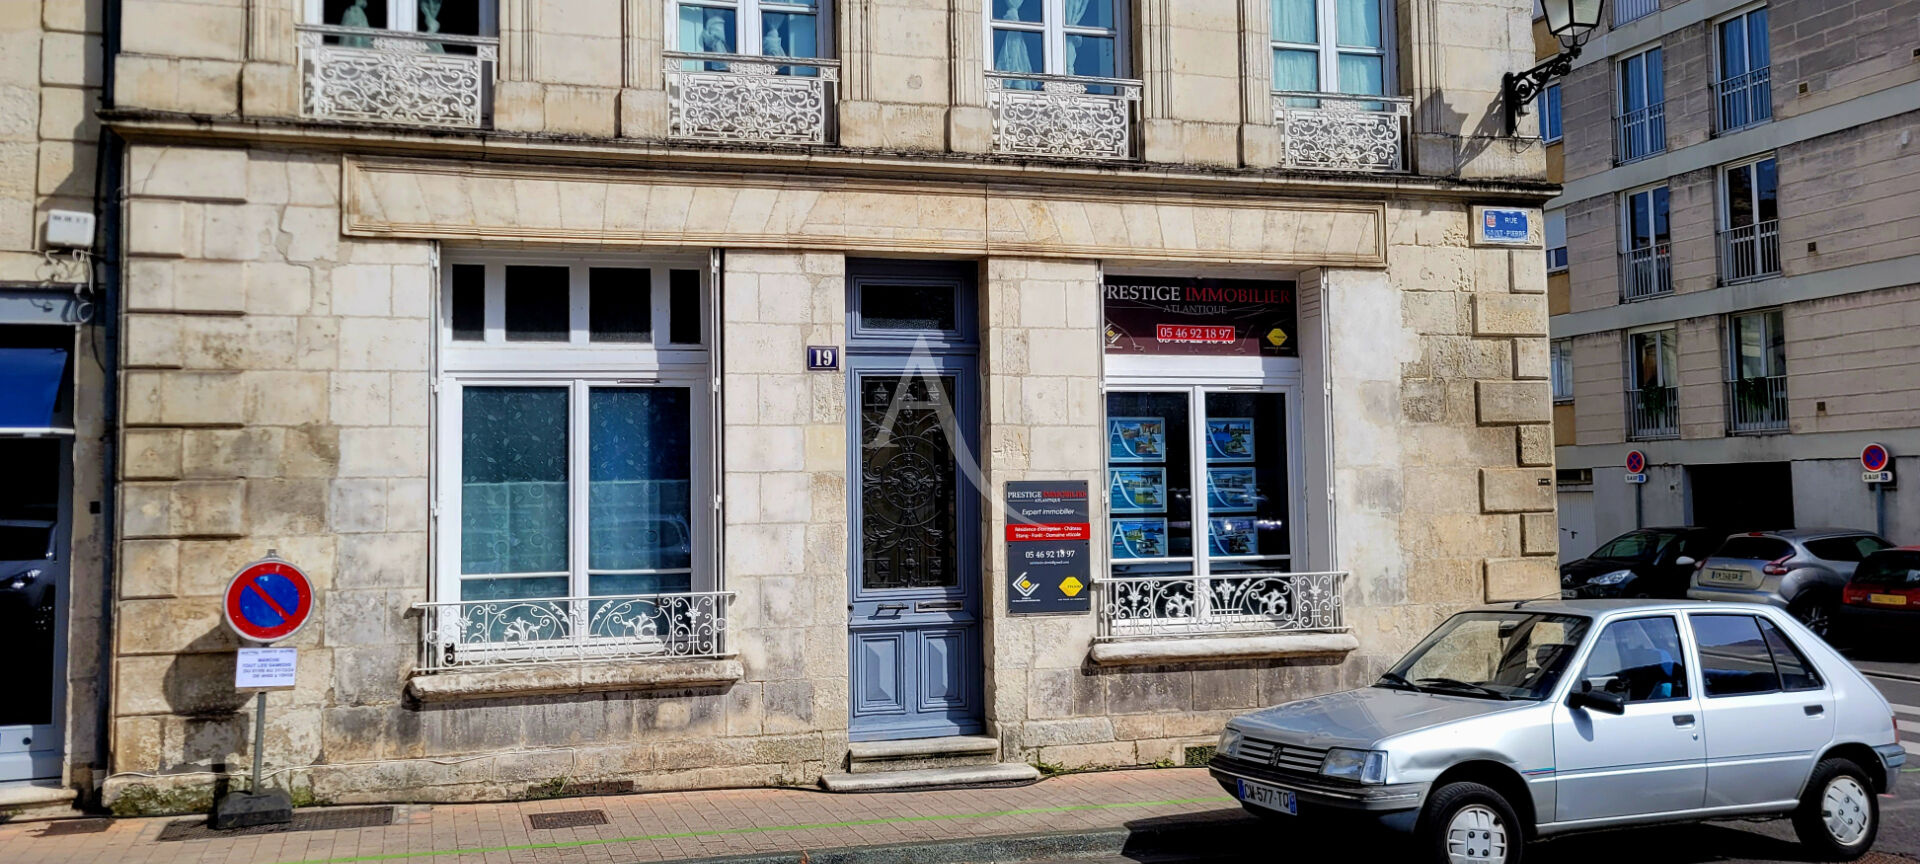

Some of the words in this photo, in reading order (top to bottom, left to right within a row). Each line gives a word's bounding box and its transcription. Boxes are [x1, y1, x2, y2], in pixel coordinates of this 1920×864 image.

[1185, 287, 1291, 304] IMMOBILIER
[1163, 304, 1228, 315] ATLANTIQUE
[1160, 327, 1173, 338] 05
[1175, 327, 1187, 338] 46
[1190, 328, 1202, 338] 92
[1205, 328, 1217, 338] 18
[1219, 328, 1231, 339] 97
[815, 349, 833, 366] 19
[1007, 491, 1042, 499] PRESTIGE
[1022, 508, 1042, 516] Expert
[1025, 551, 1034, 559] 05
[1045, 550, 1055, 558] 92
